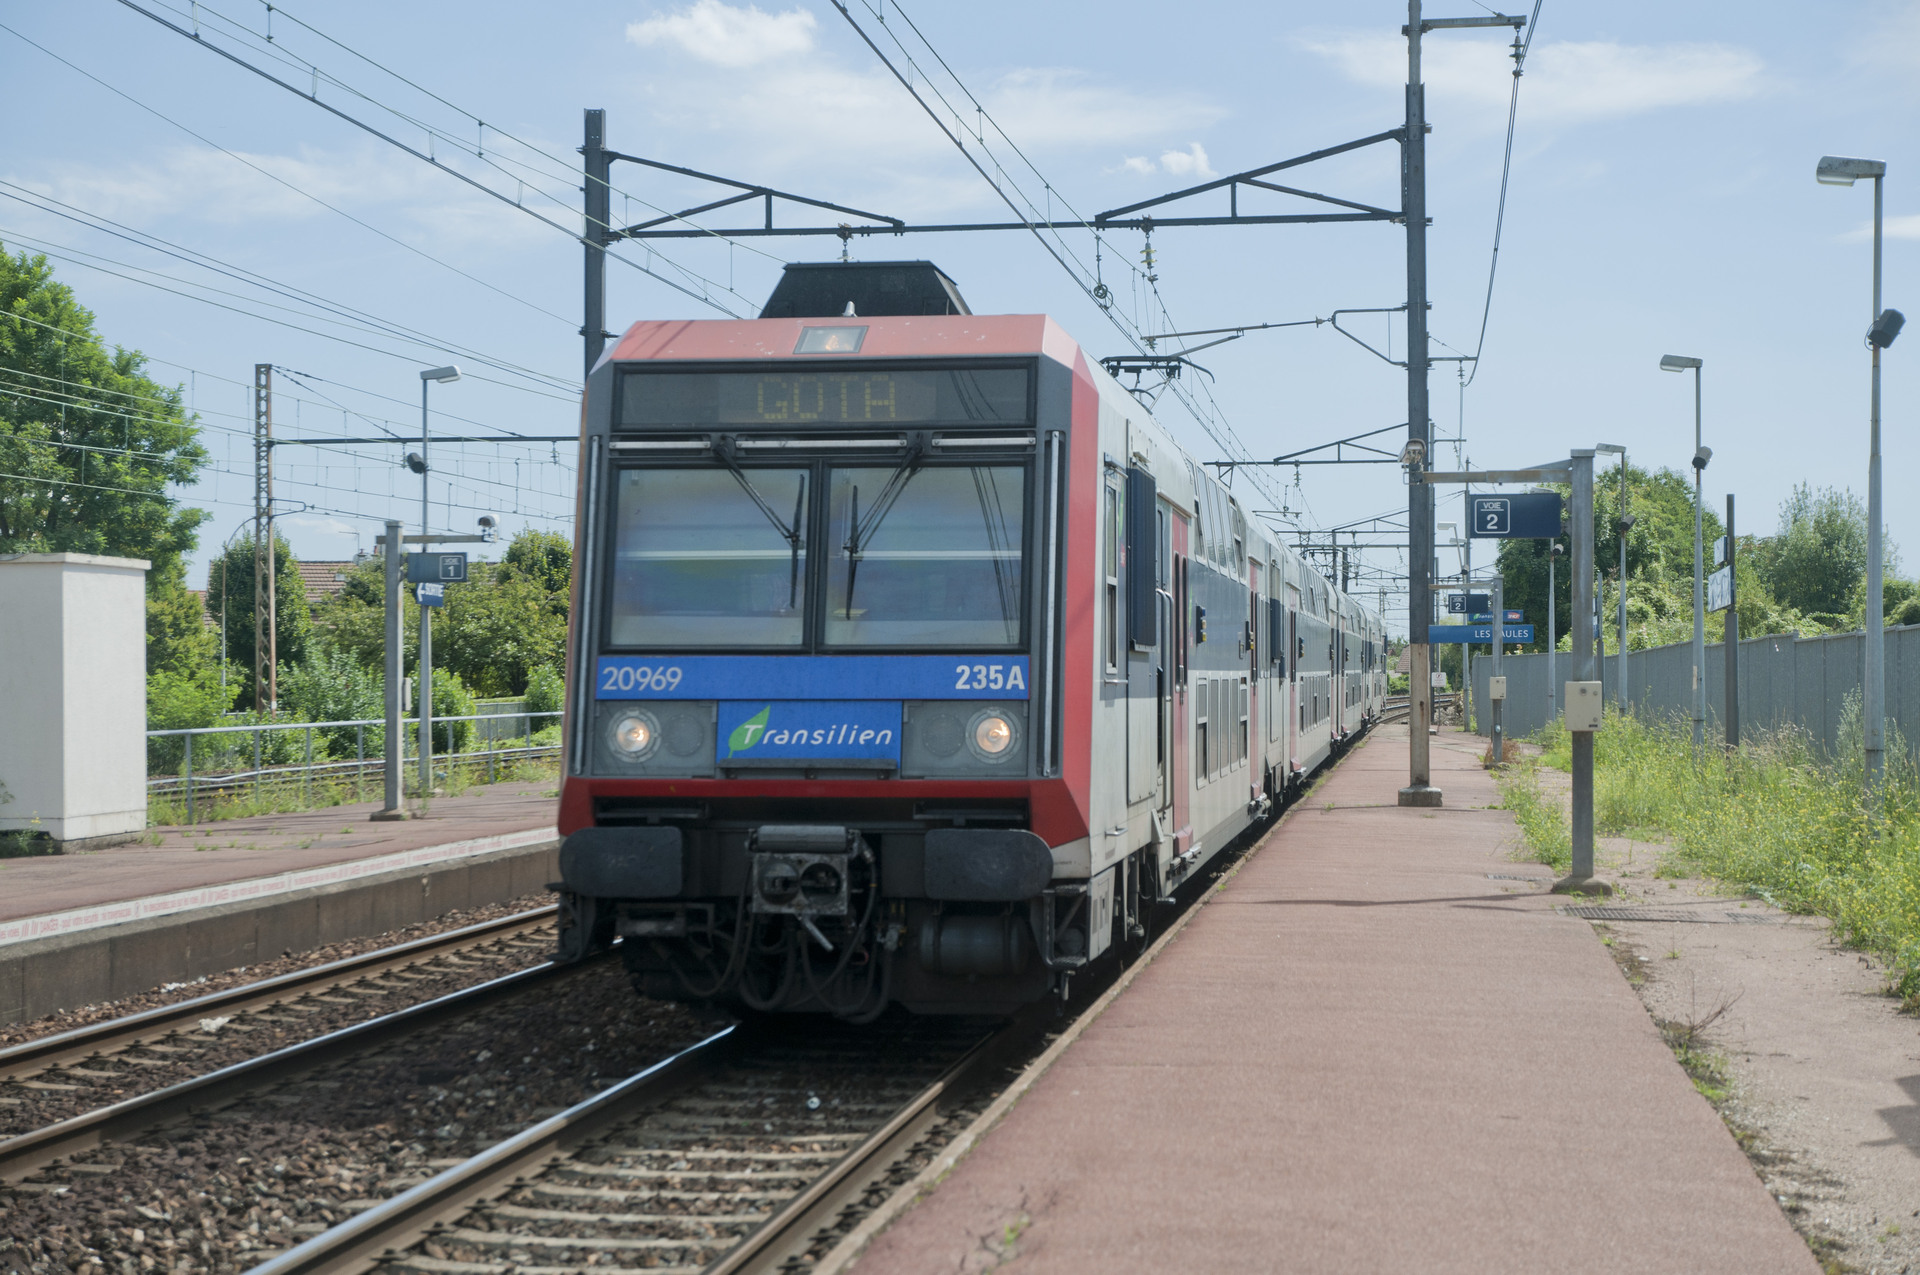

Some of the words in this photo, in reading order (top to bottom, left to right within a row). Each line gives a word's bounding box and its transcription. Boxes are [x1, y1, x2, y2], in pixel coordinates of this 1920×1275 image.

[757, 374, 896, 419] GOTA
[1487, 514, 1498, 529] 2
[448, 566, 454, 576] 1
[602, 666, 683, 691] 20969
[955, 664, 1026, 690] 235A
[744, 724, 892, 744] Transilien
